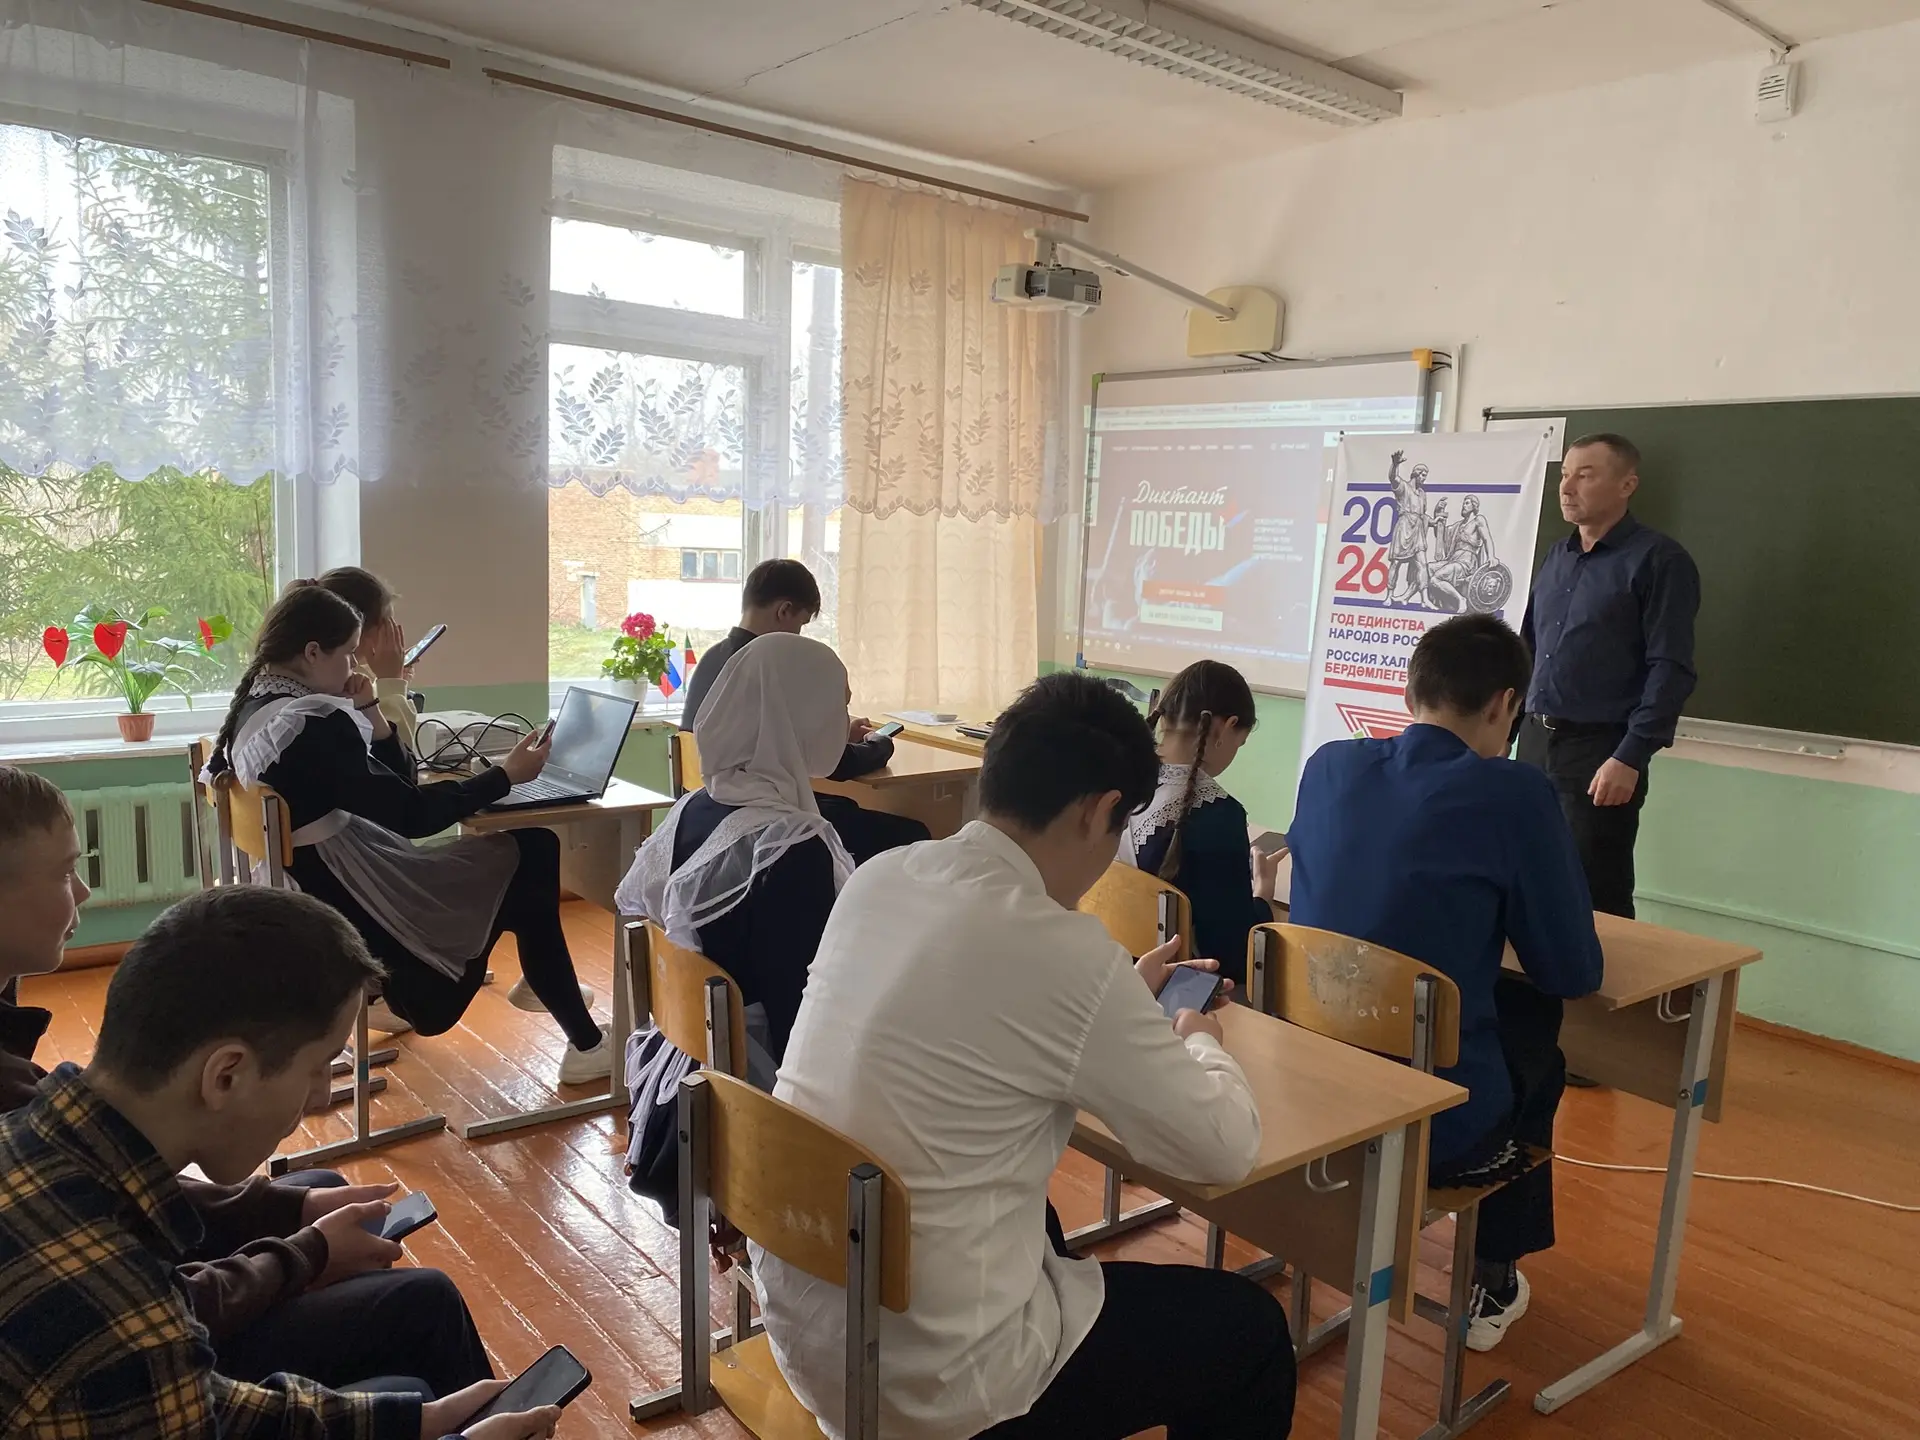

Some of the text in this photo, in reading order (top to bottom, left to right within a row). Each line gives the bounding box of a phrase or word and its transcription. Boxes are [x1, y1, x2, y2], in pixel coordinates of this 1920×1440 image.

[1132, 480, 1228, 505] Диктант
[1341, 496, 1398, 545] 20
[1129, 510, 1226, 556] ПОБЕДЫ
[1335, 545, 1389, 594] 26
[1330, 612, 1425, 632] ГОД ЕДИНСТВА
[1328, 628, 1389, 644] НАРОДОВ
[1326, 649, 1377, 665] РОССИЯ
[1325, 662, 1407, 682] БЕРДӘМЛЕГЕ
